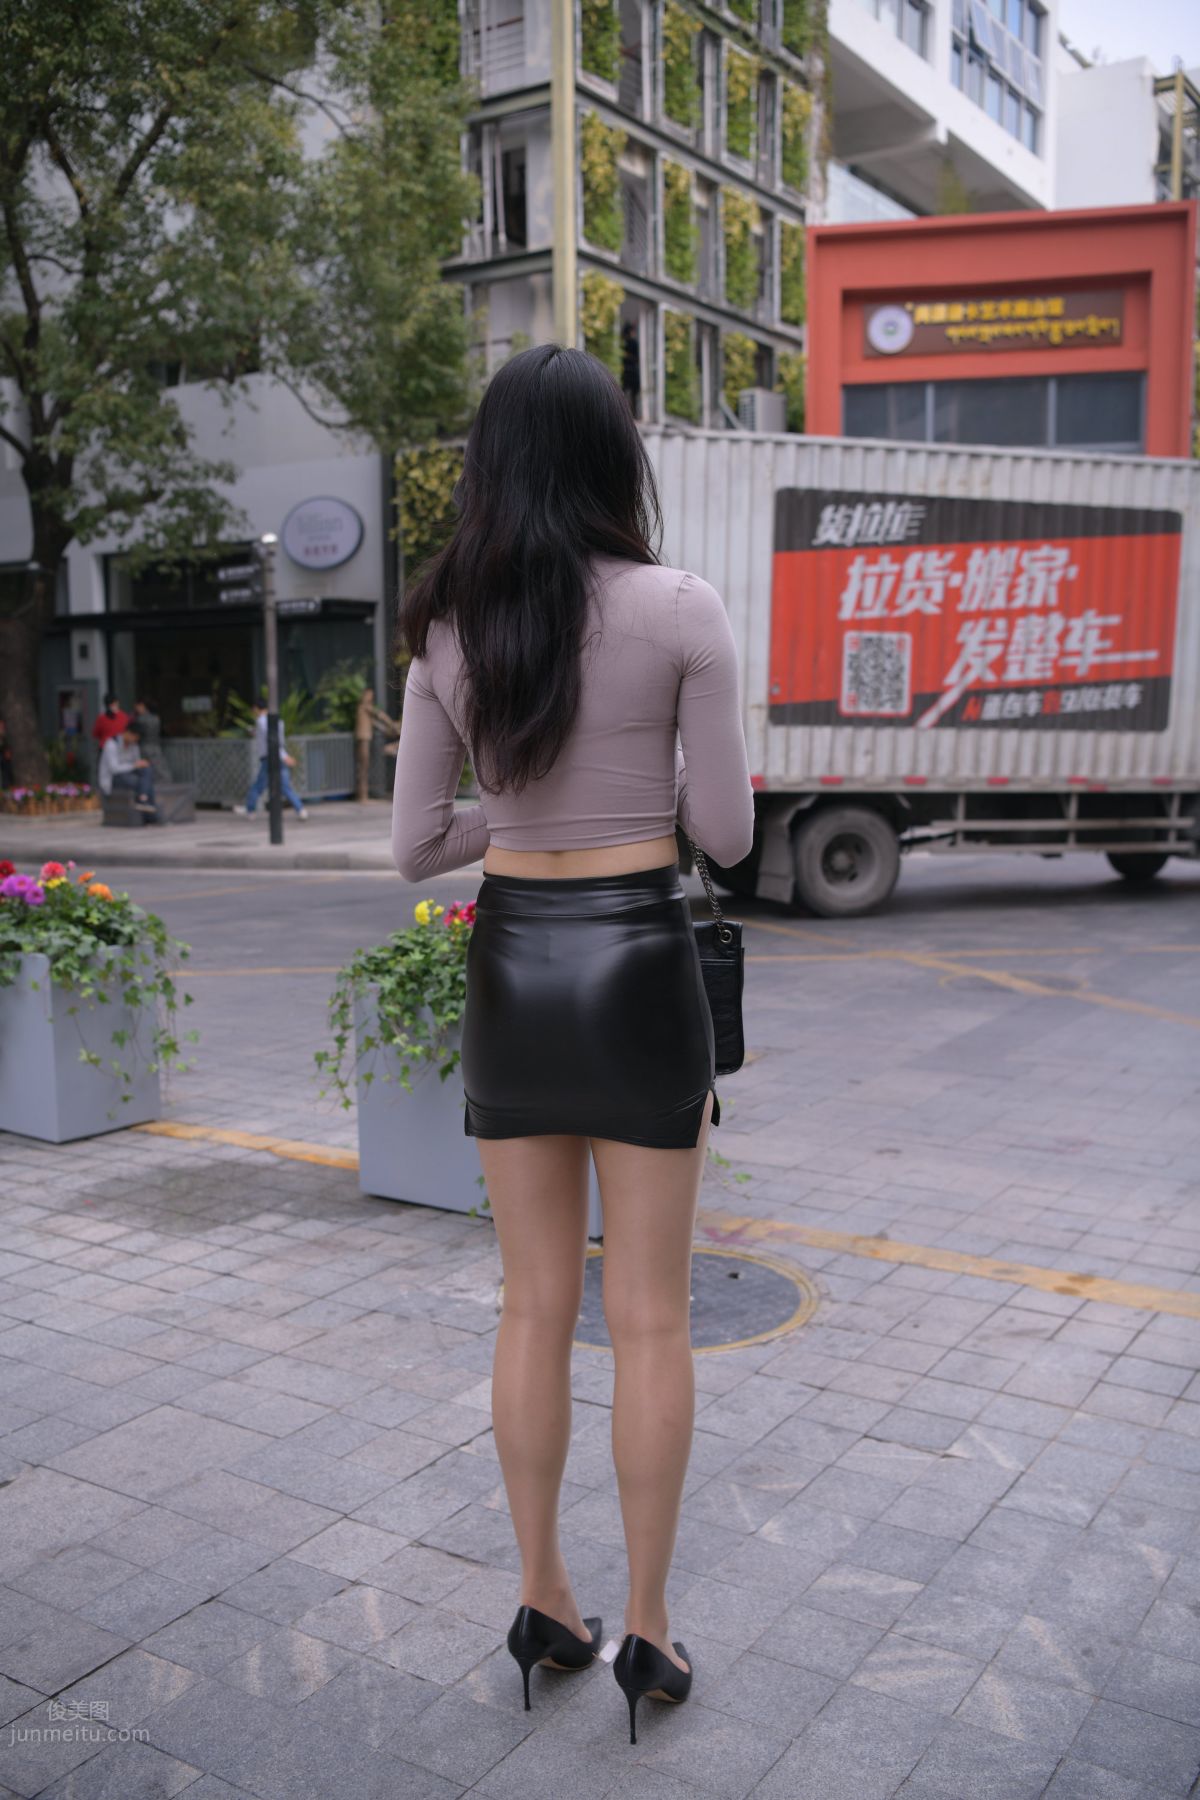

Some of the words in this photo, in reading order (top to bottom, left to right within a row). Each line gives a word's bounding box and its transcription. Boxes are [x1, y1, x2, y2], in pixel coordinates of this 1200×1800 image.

[812, 501, 927, 546] 货拉拉
[930, 610, 1159, 694] 发整车
